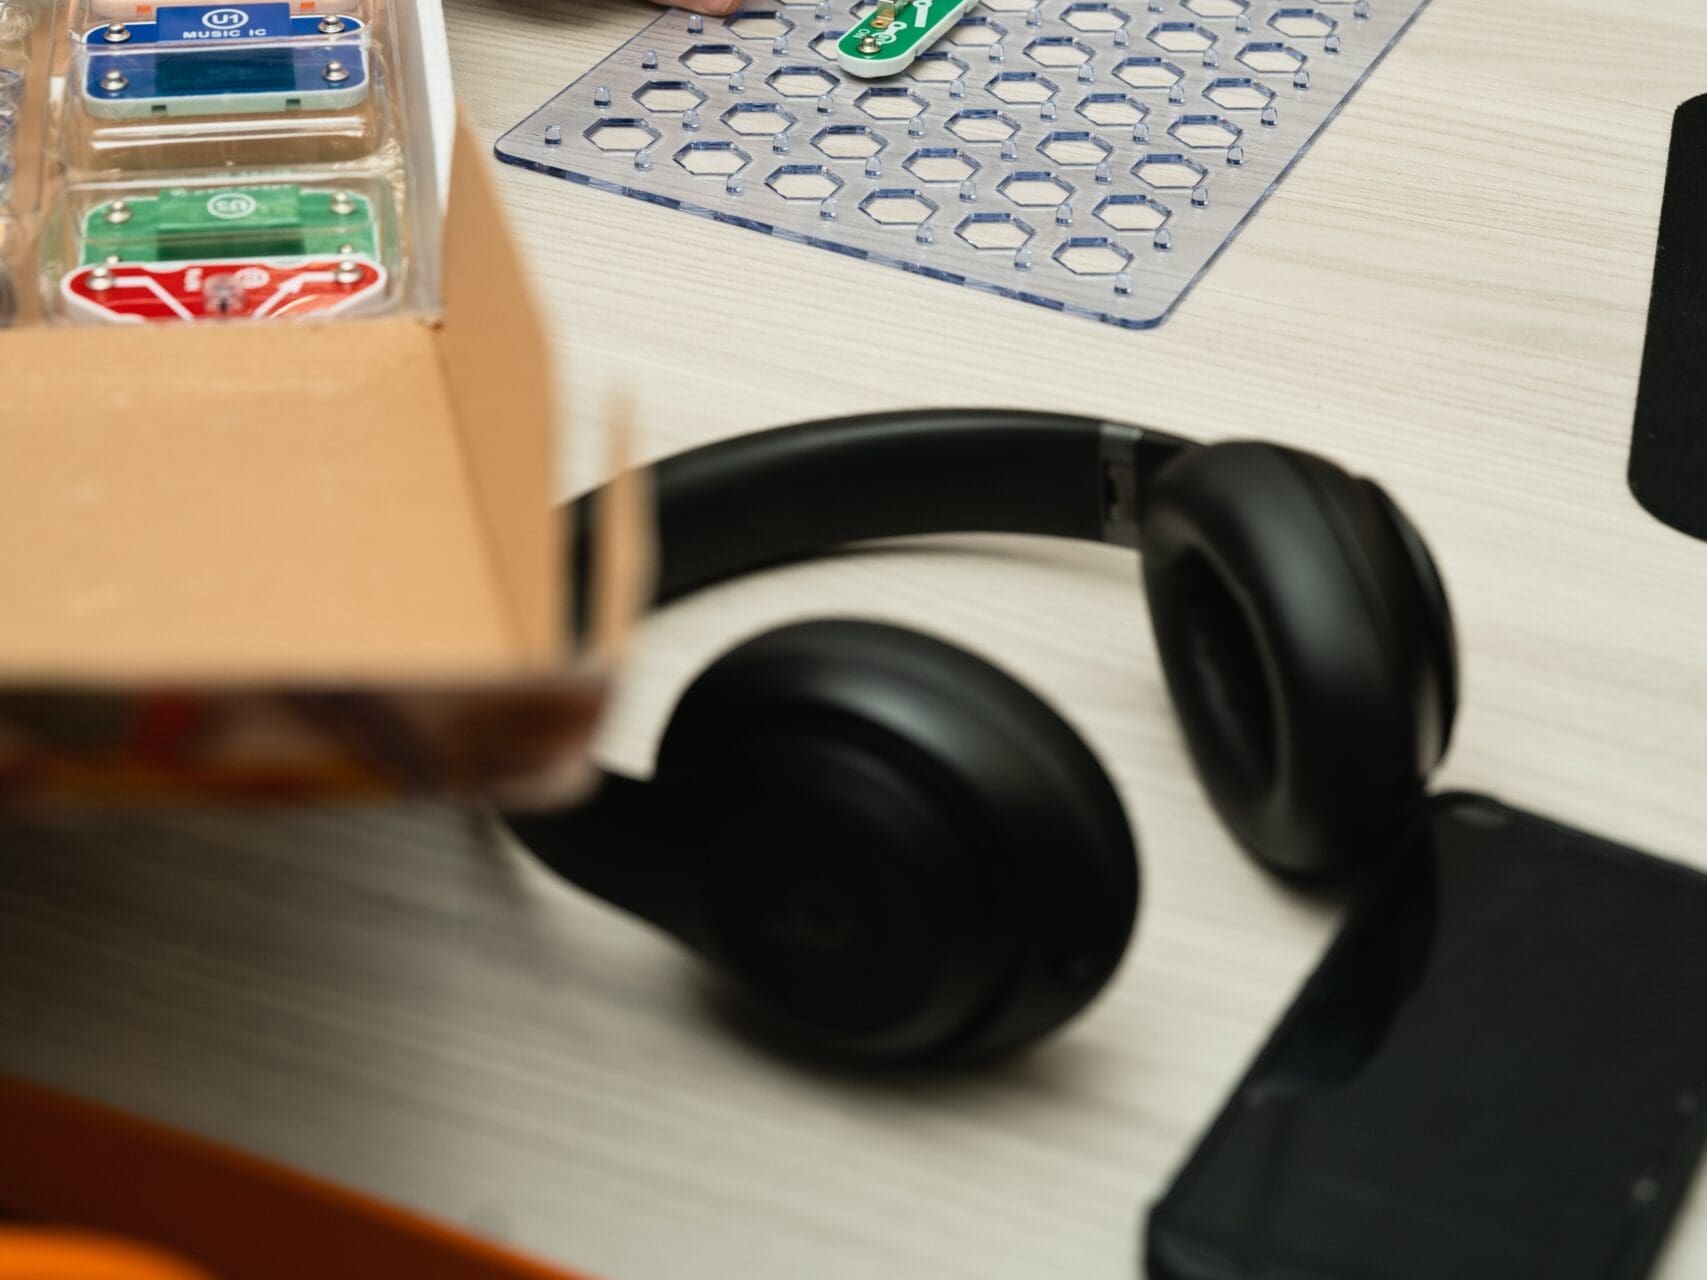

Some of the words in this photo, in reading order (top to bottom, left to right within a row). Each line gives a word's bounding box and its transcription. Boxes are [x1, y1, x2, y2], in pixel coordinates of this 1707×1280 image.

[211, 14, 240, 24] U1
[182, 29, 241, 39] MUSIC
[248, 28, 267, 37] IC
